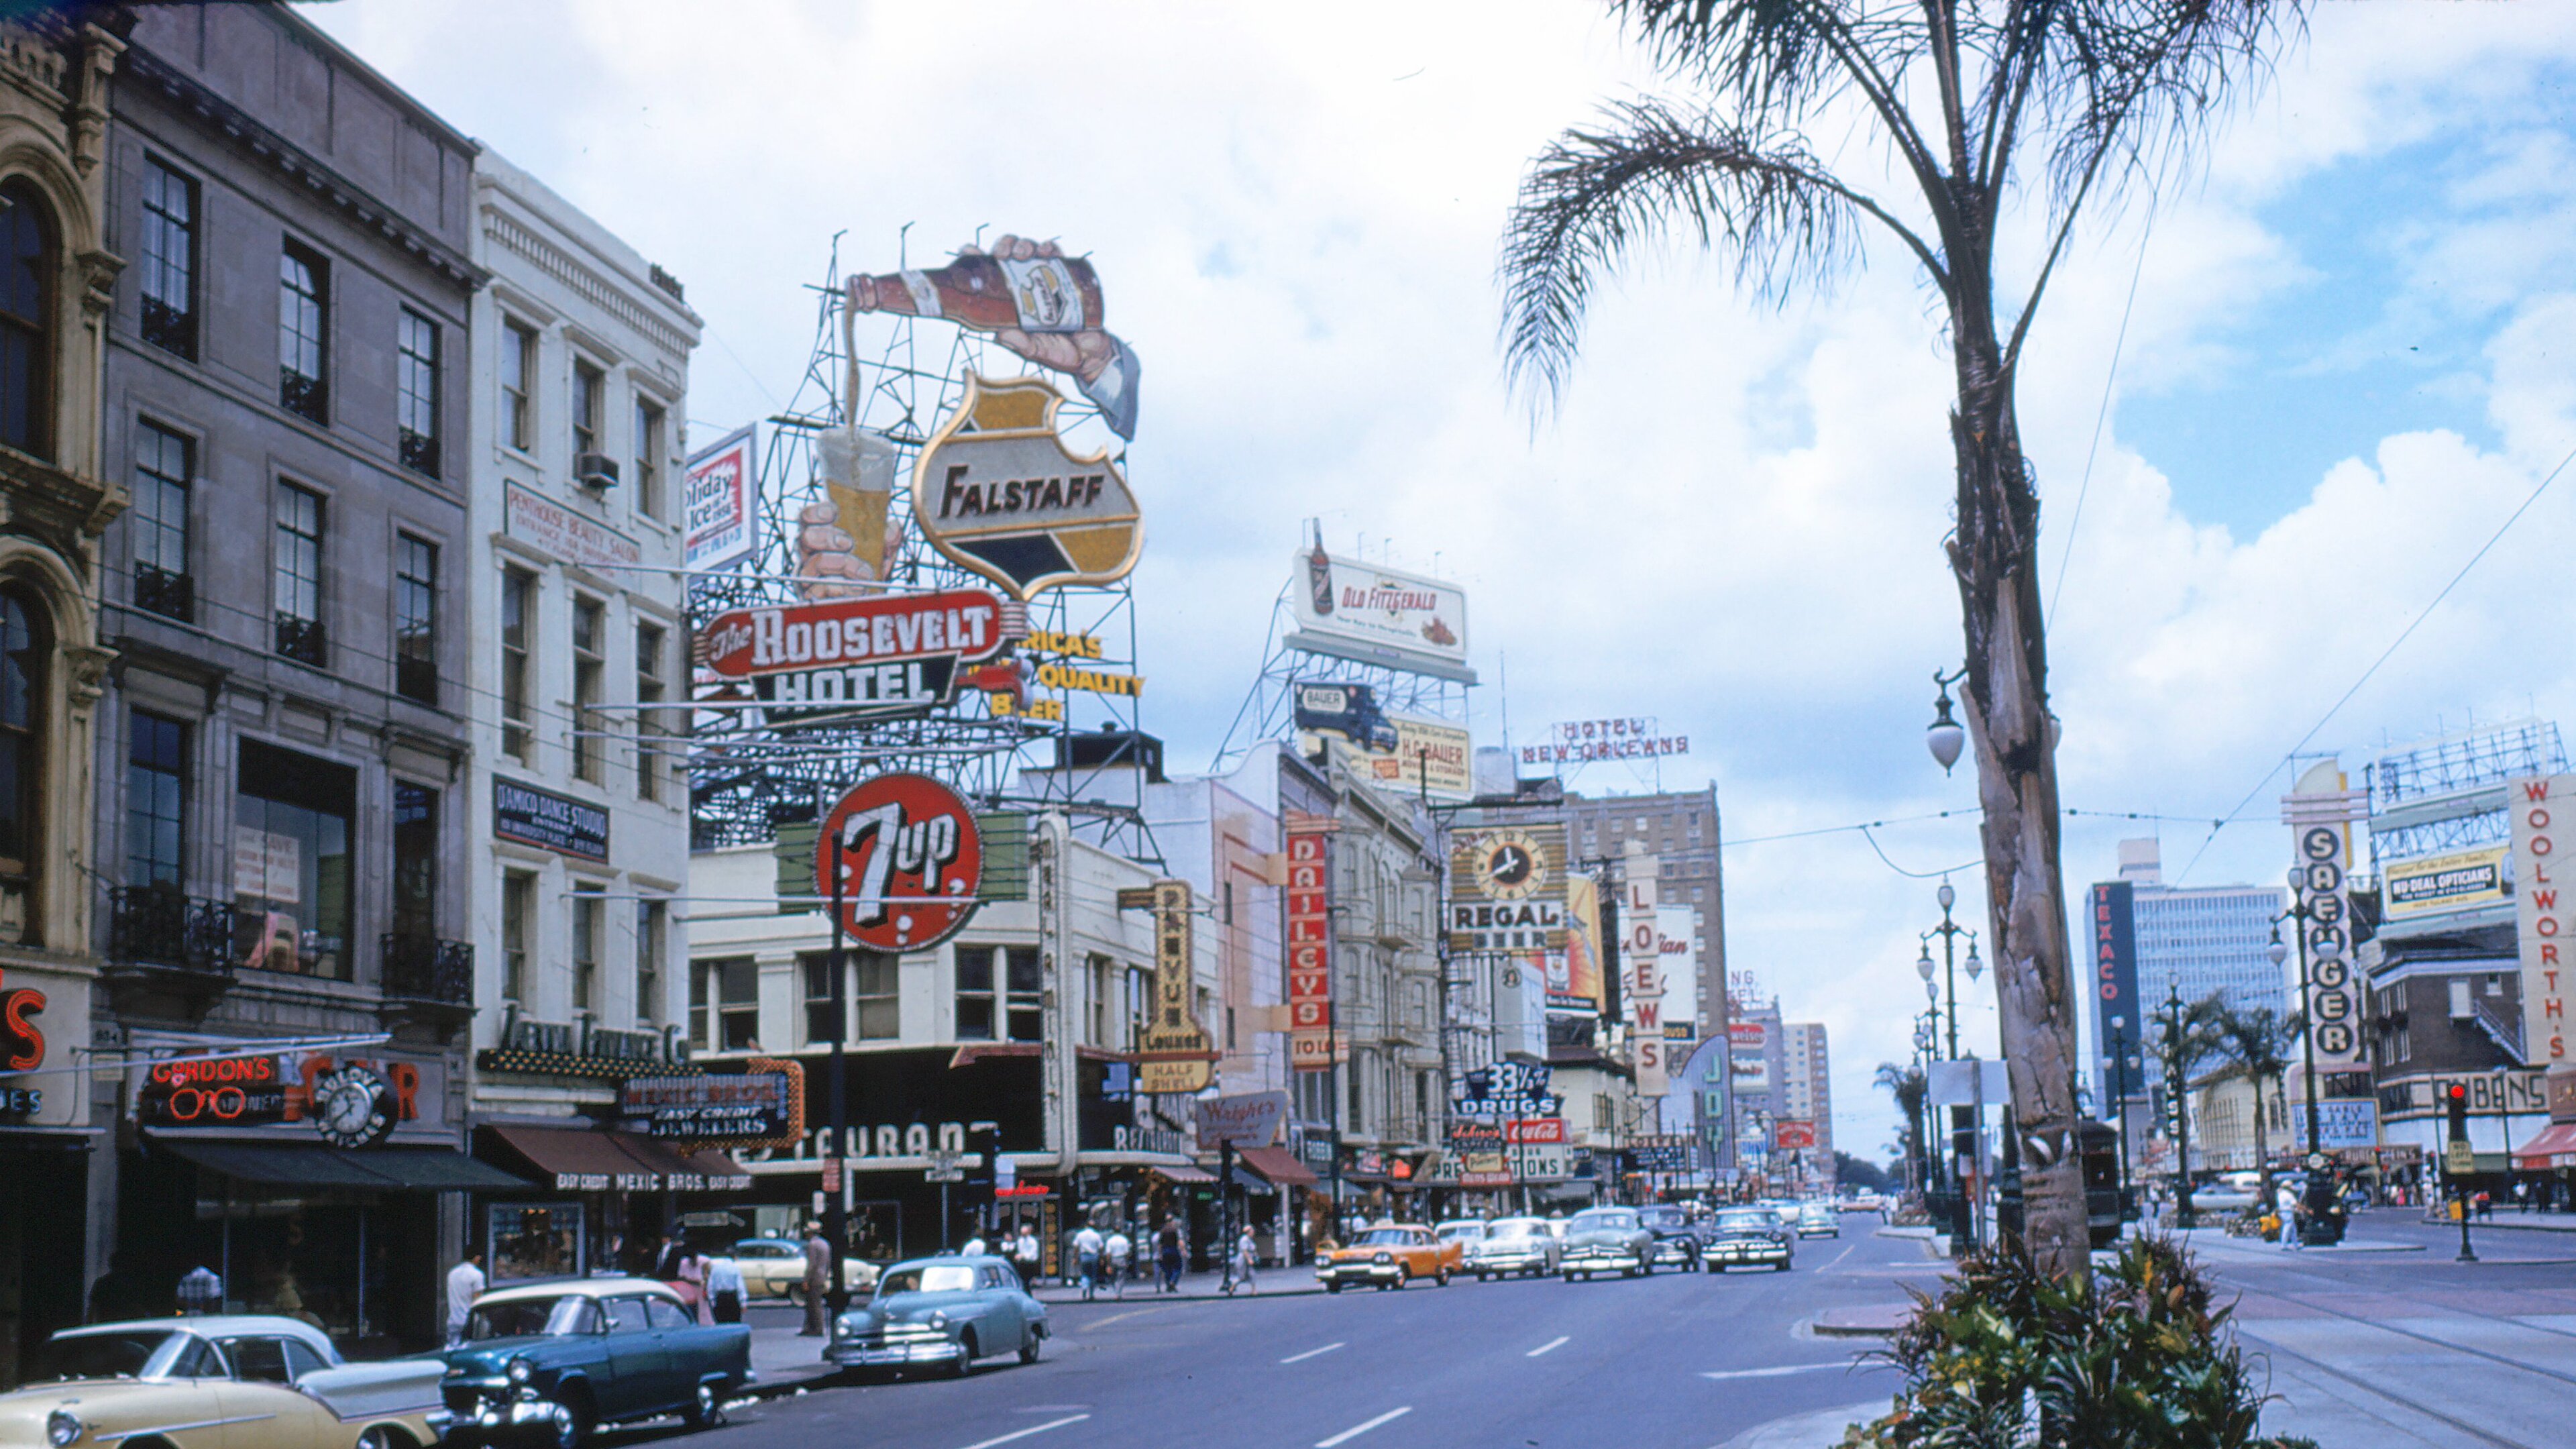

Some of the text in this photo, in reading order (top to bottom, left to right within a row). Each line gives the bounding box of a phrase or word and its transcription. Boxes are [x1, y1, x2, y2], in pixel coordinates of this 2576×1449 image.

[939, 466, 1104, 519] FALSTAFF
[1342, 586, 1437, 611] OLD FITZGERALD
[711, 606, 994, 666] The ROOSEVELT
[774, 661, 934, 712] HOTEL
[1038, 664, 1146, 698] QUALITY
[991, 694, 1063, 722] BER
[1307, 691, 1340, 704] BAUER
[1564, 718, 1645, 739] HOTEL
[1522, 737, 1689, 763] NEW ORLEANS
[2393, 875, 2436, 895] NU-DEAL
[2438, 867, 2493, 888] OPTICIANS
[1455, 905, 1559, 929] REGAL
[2524, 781, 2565, 1059] WOOLWORTH'S
[2096, 885, 2118, 1001] TEXACO
[1633, 885, 1658, 1068] LOEWS
[154, 1057, 269, 1083] GORDON'S
[655, 1106, 762, 1120] EASY CREDIT
[1462, 1099, 1556, 1114] DRUGS
[1704, 1054, 1723, 1152] JOY
[651, 1118, 768, 1136] JEWELERS
[616, 1173, 660, 1191] MEXIC
[667, 1173, 705, 1191] BROS.
